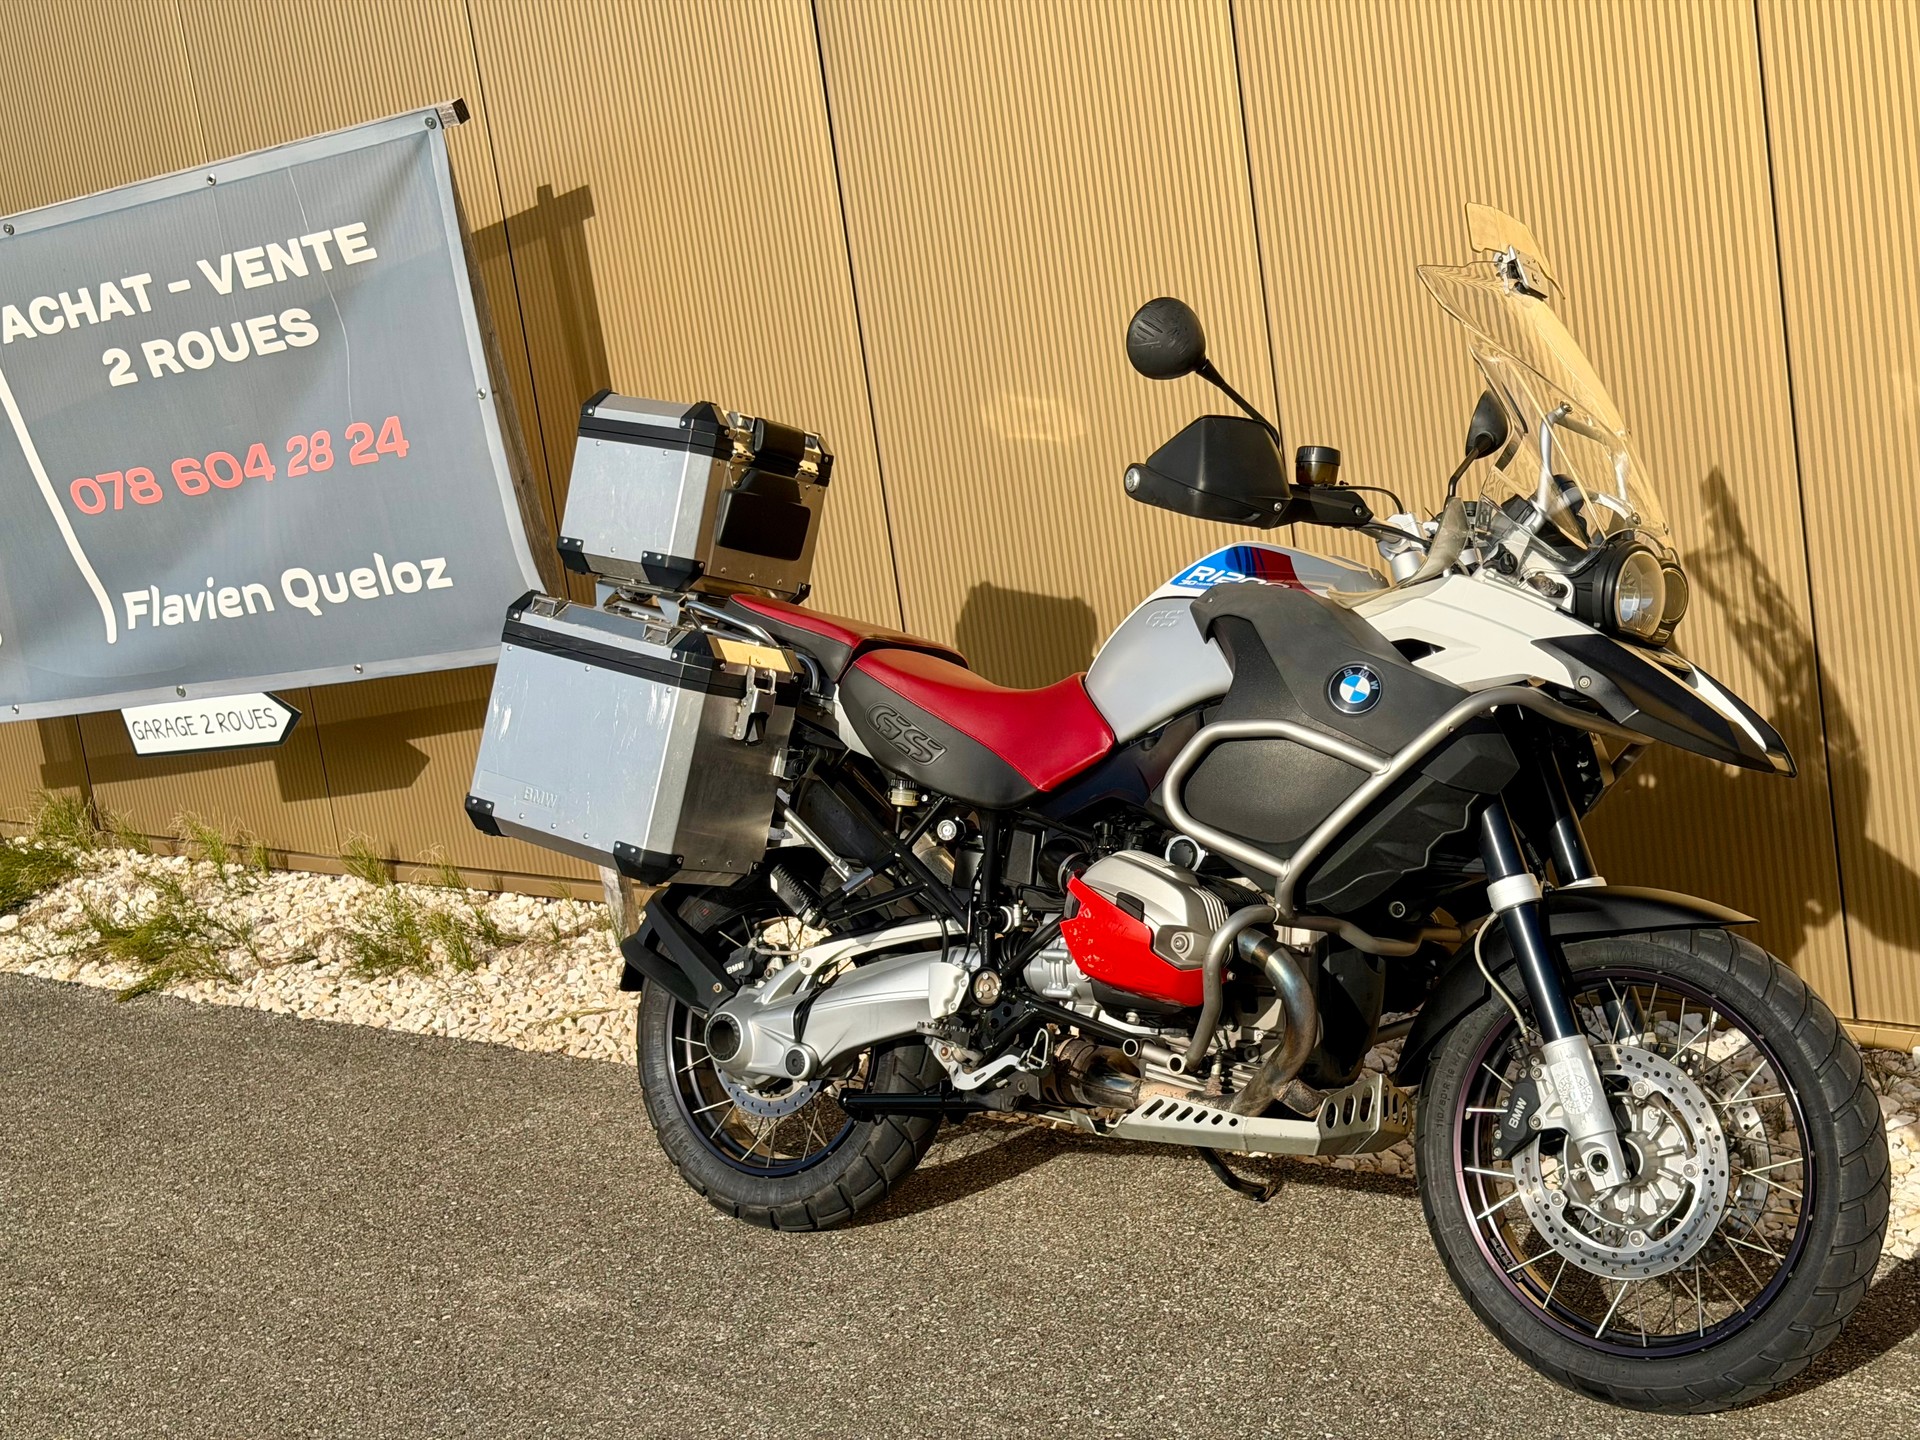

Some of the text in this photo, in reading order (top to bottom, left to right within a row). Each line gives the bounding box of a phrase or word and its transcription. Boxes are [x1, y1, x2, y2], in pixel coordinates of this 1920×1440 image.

[2, 272, 152, 344] ACHAT
[196, 221, 378, 295] VENTE
[101, 307, 320, 388] 2 ROUES
[69, 415, 410, 515] 078 604 28 24
[122, 552, 454, 630] Flavien Queloz
[1343, 668, 1379, 690] BMW
[131, 707, 278, 741] GARAGE 2 ROUES
[867, 704, 945, 764] GS
[523, 785, 558, 809] BMW
[726, 960, 745, 975] BMW
[1508, 1097, 1527, 1129] BMW
